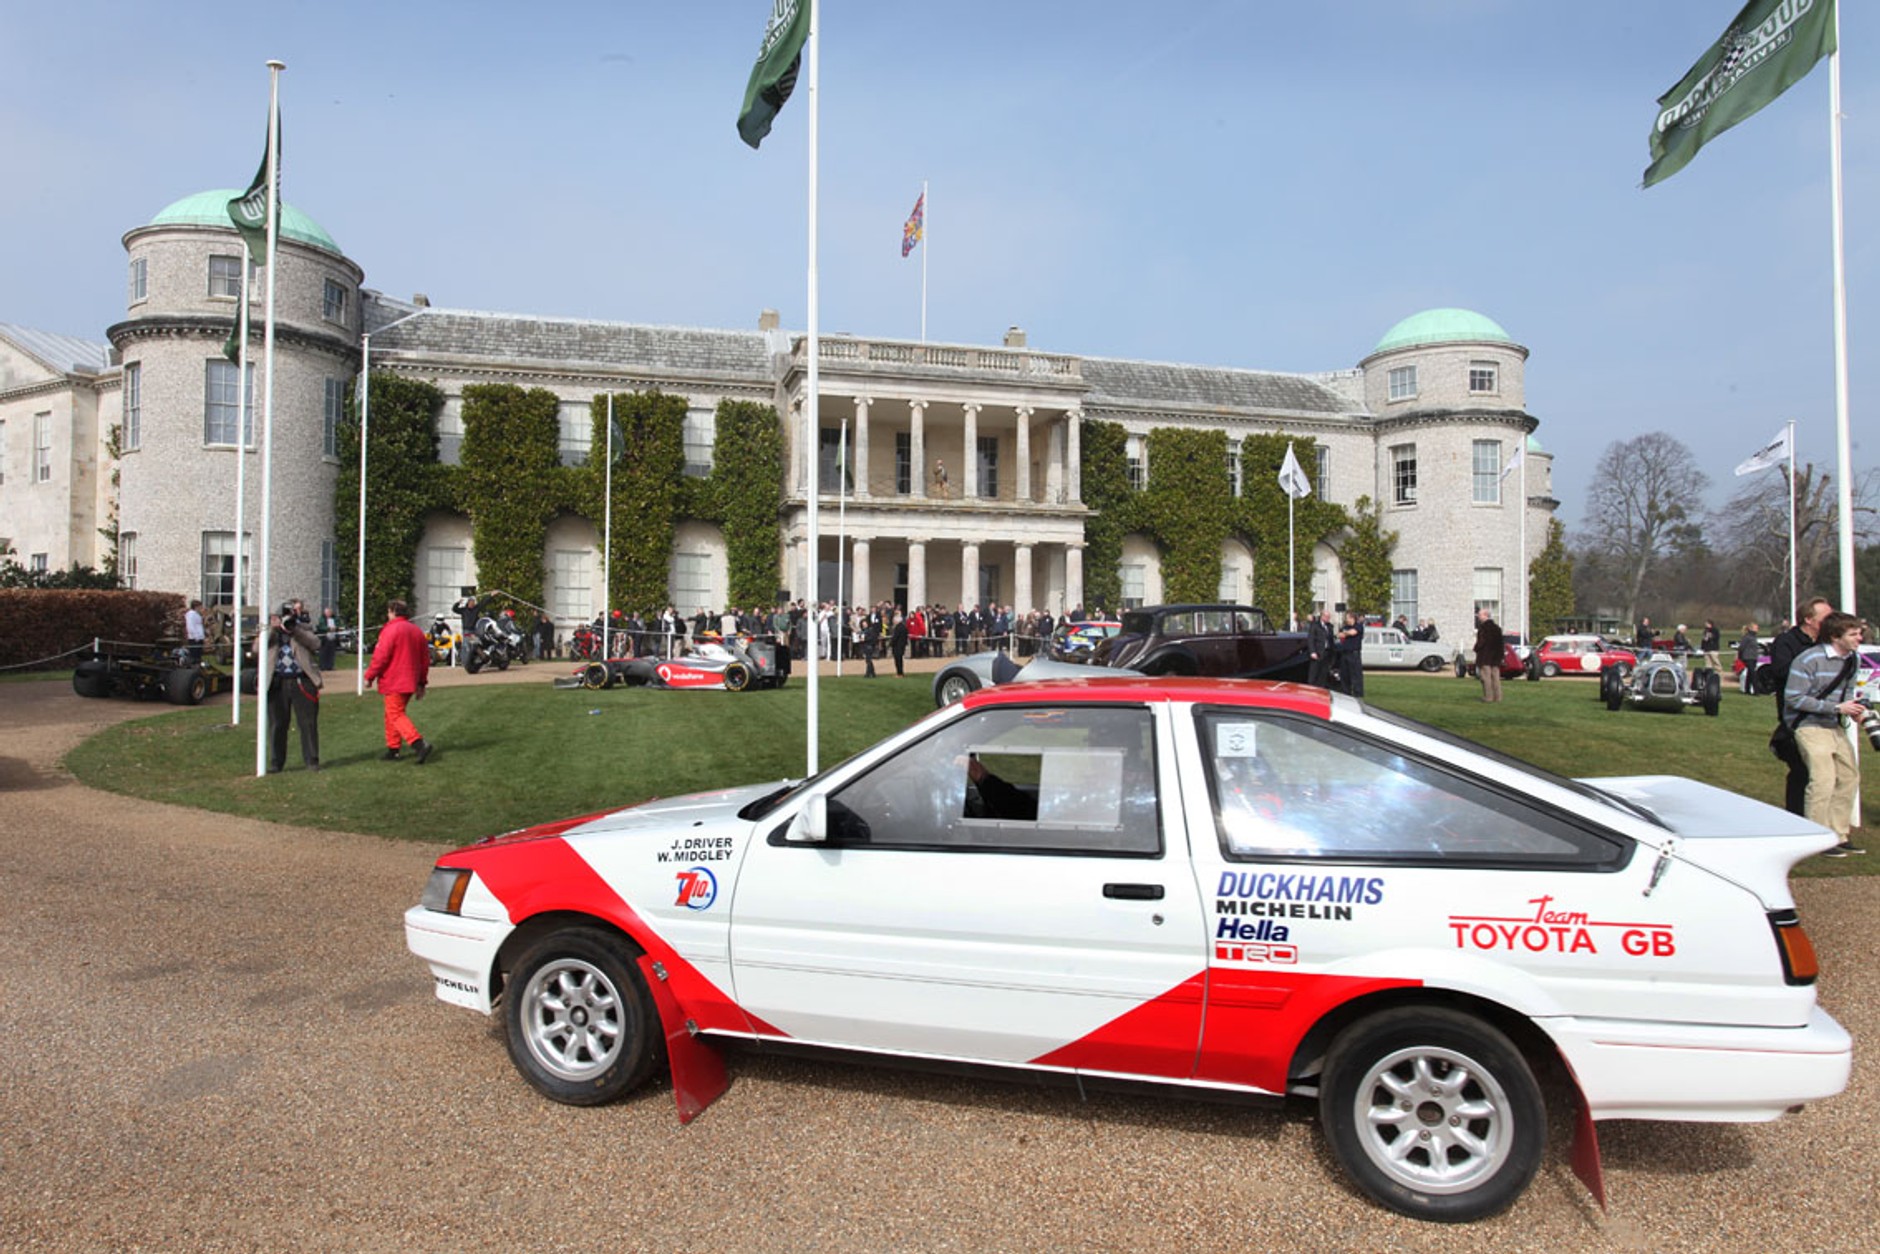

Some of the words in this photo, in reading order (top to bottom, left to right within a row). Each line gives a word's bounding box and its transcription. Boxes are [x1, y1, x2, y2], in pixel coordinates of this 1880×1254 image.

[657, 852, 672, 862] W.
[674, 850, 733, 861] MIDGLEY
[671, 840, 682, 850] J.
[684, 838, 733, 849] DRIVER
[1216, 871, 1385, 905] DUCKHAMS
[1216, 899, 1352, 920] MICHELIN
[1528, 895, 1588, 925] Team
[1216, 917, 1289, 941] Hella
[1449, 923, 1597, 954] TOYOTA
[1621, 930, 1676, 957] GB
